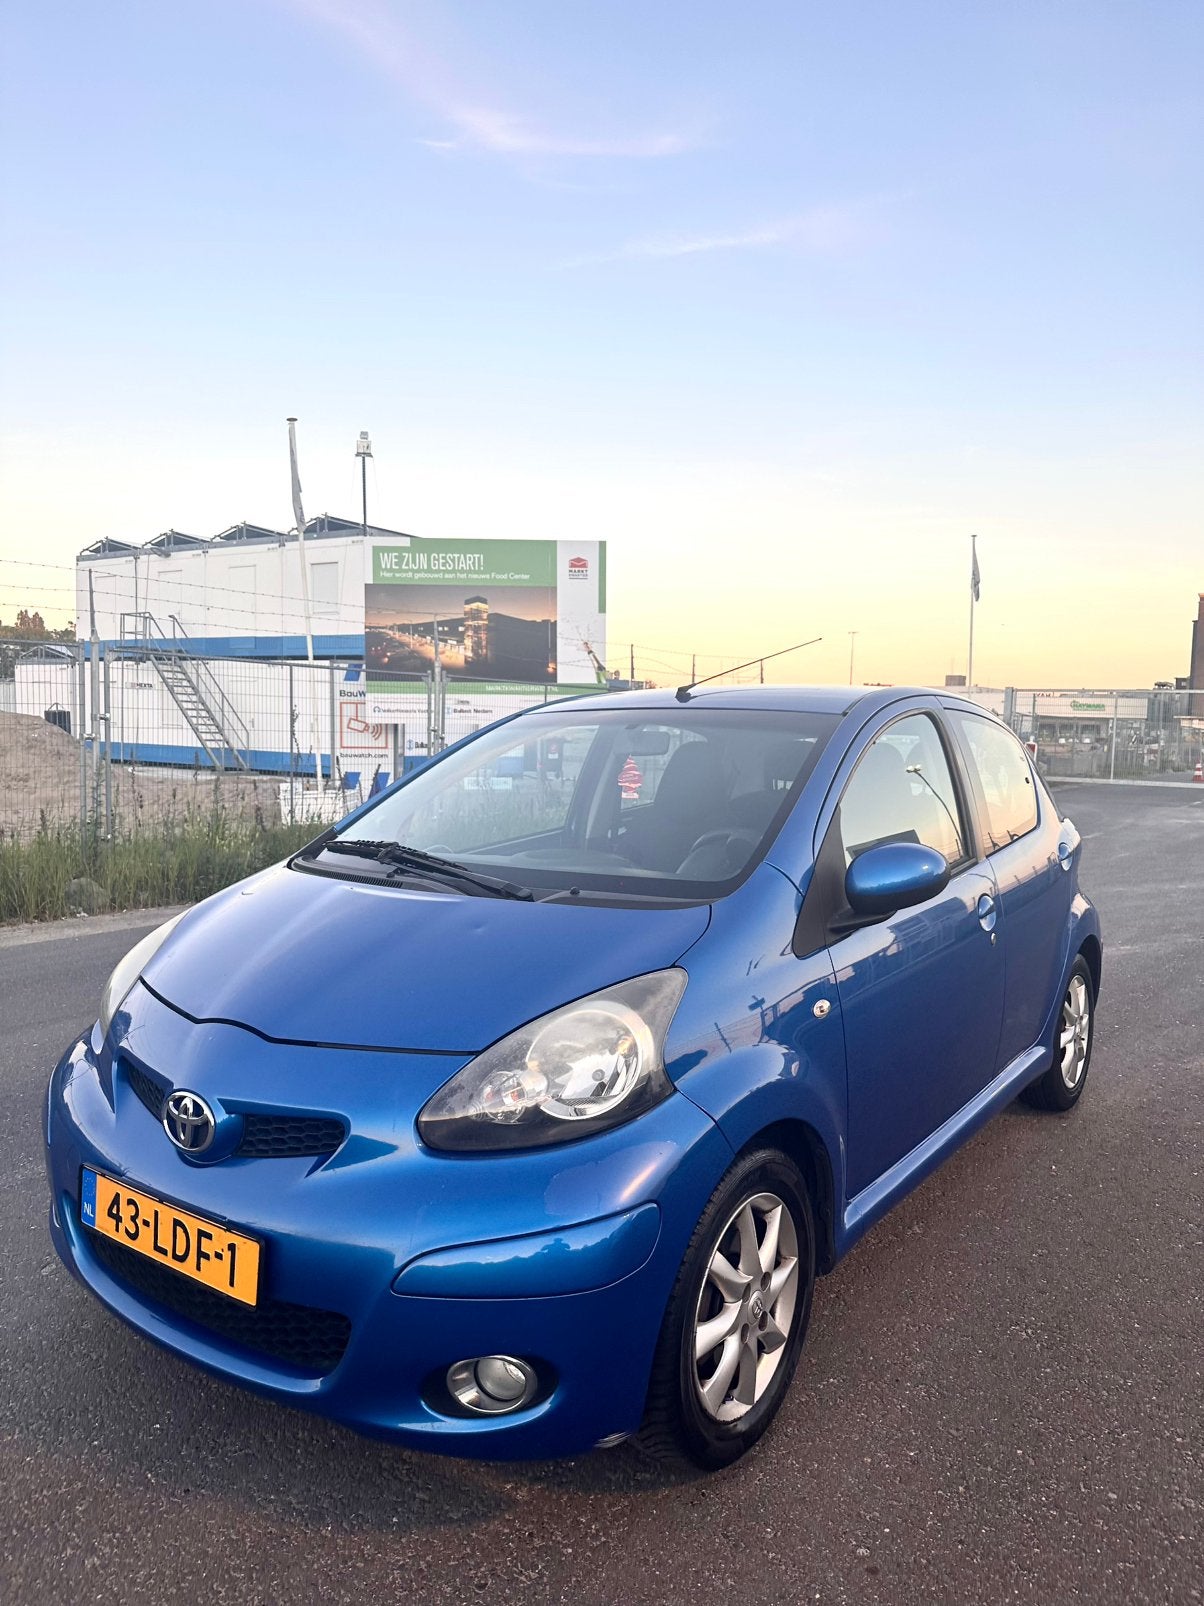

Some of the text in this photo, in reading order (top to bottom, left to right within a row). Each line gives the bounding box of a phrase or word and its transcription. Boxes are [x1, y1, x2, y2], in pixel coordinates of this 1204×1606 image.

[380, 552, 484, 571] WE ZIJN GESTART!
[414, 571, 443, 580] gebouwd
[508, 572, 530, 580] Center
[84, 1192, 237, 1288] NL 43-LDF-1
